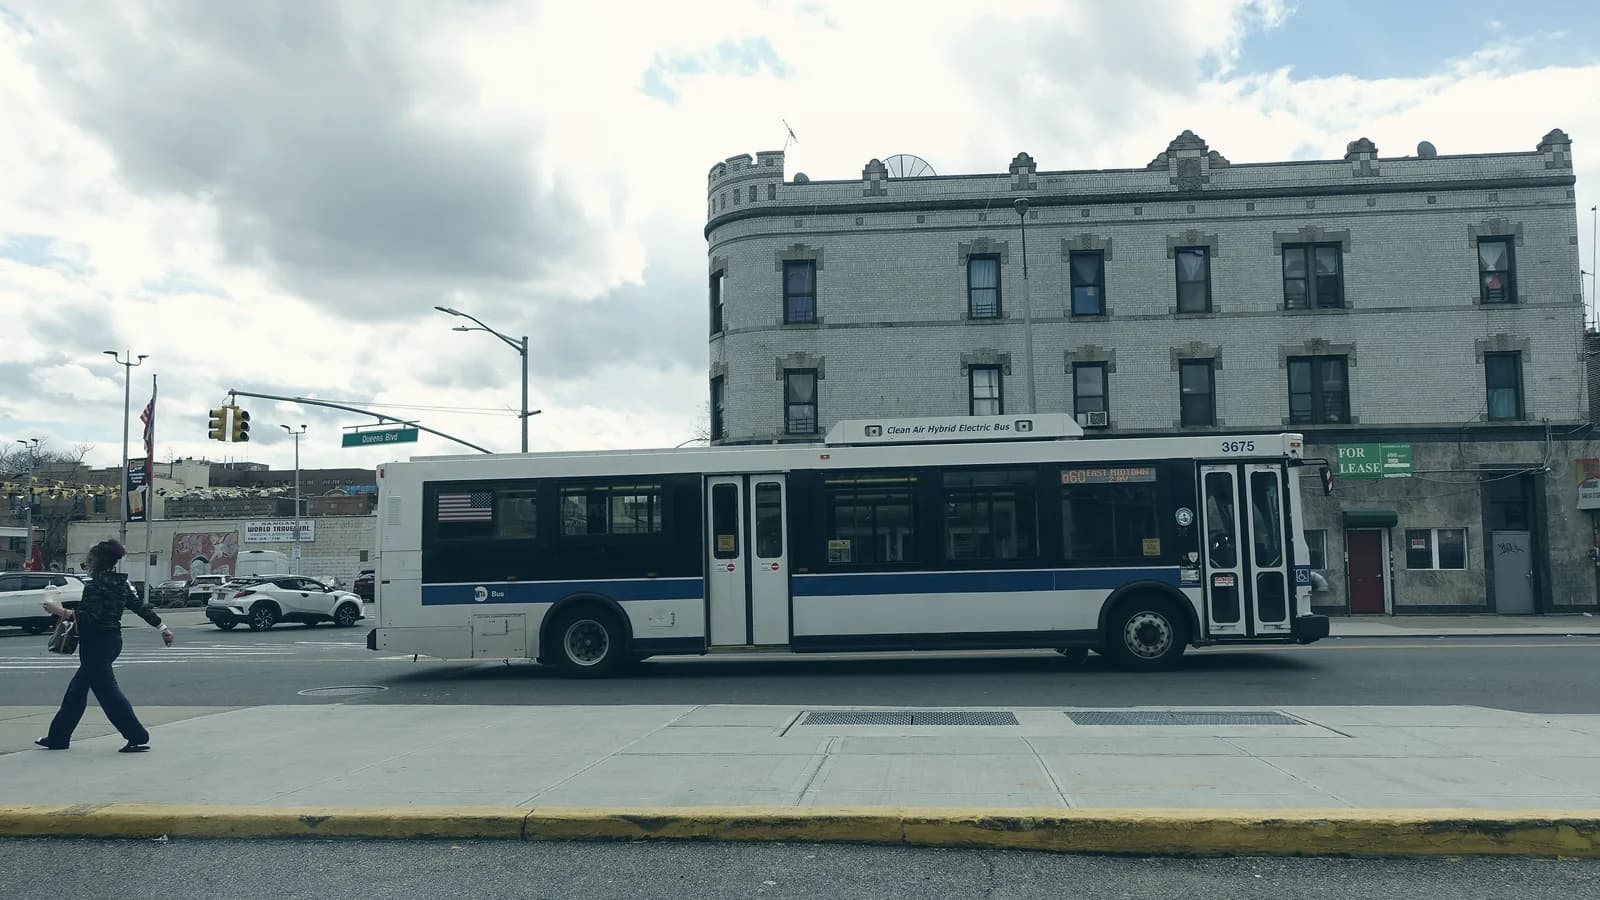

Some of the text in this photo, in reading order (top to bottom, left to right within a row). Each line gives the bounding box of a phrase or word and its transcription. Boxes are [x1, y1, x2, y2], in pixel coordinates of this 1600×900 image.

[887, 423, 1010, 434] Clean Air Hybrid Electric Bus
[362, 433, 398, 443] Queens Blvd
[1221, 441, 1255, 453] 3675
[1338, 447, 1365, 458] FOR
[1087, 469, 1107, 477] EAST
[1340, 462, 1381, 473] LEASE
[491, 590, 505, 598] Bus
